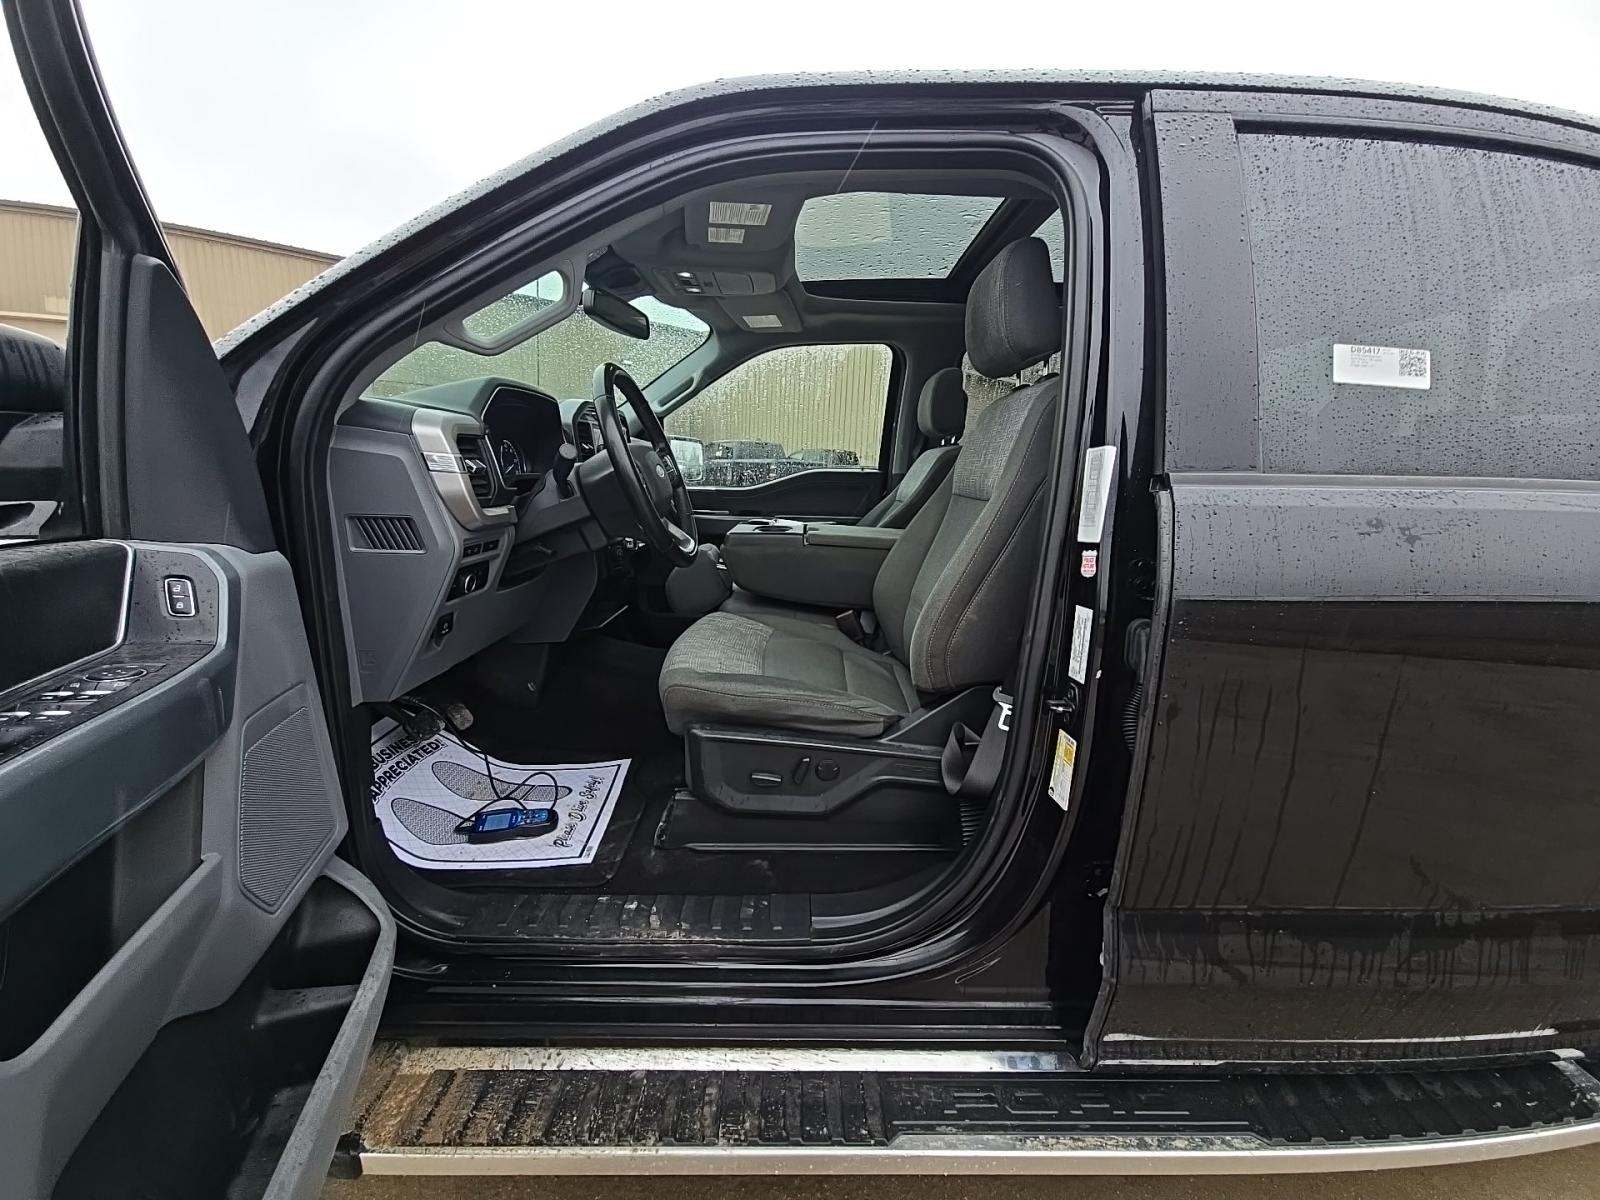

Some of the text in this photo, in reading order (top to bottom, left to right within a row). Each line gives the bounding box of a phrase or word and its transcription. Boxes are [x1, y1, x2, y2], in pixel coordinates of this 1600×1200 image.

[368, 738, 445, 802] APPRECIATED!
[553, 822, 578, 848] Please
[568, 800, 588, 822] Drive
